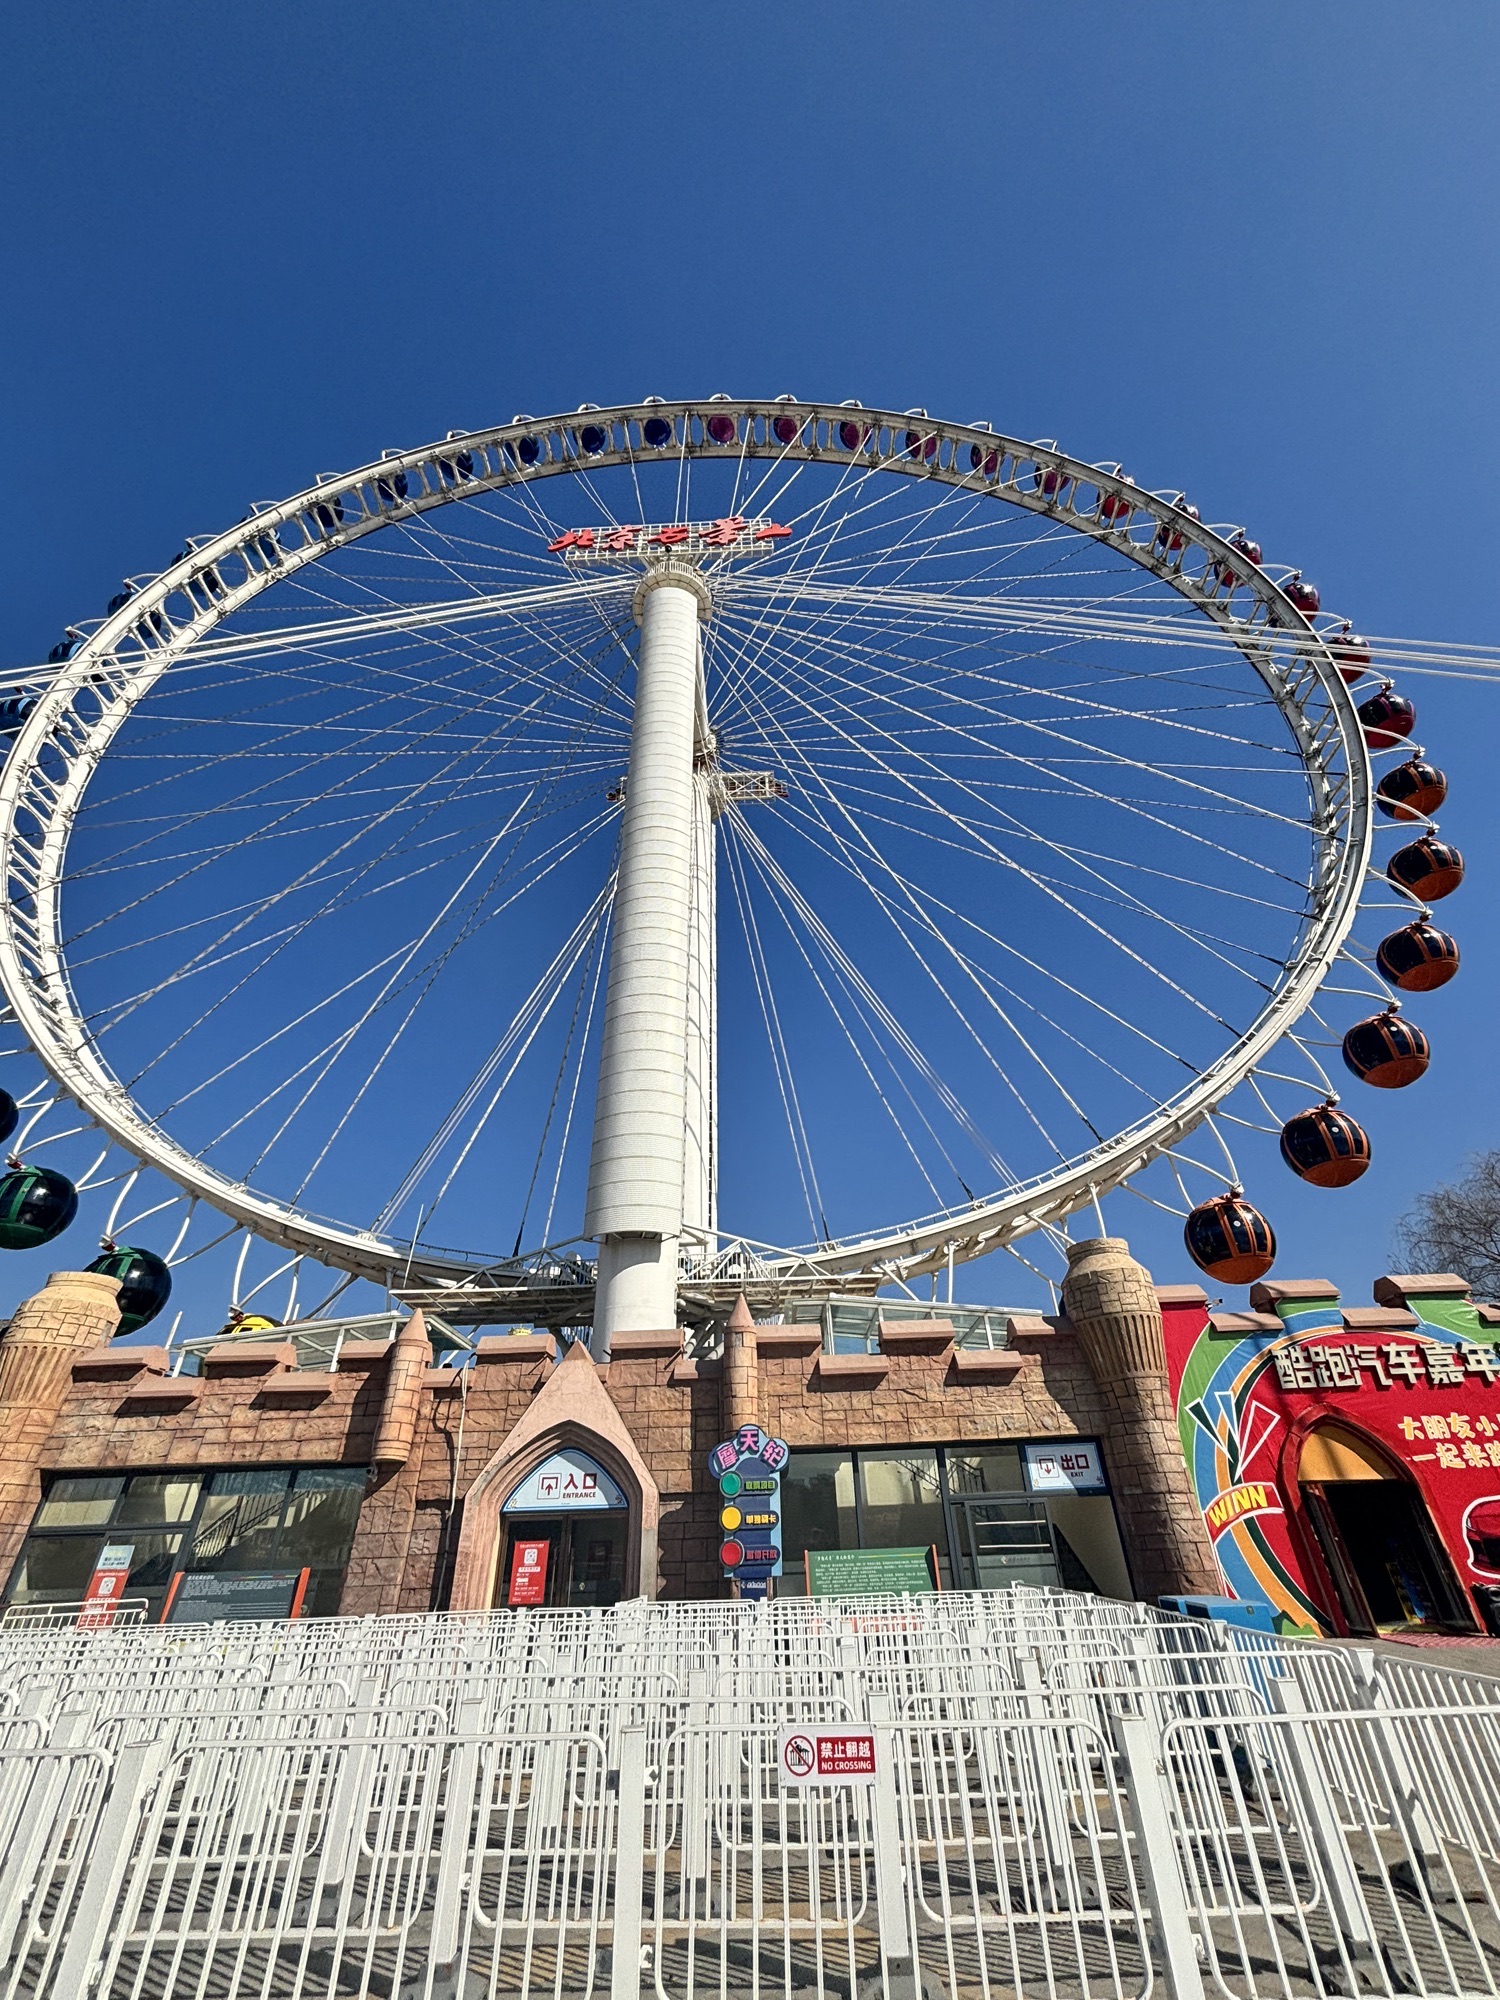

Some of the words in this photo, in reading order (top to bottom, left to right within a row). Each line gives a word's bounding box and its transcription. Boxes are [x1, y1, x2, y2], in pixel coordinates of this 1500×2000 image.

[1397, 1412, 1500, 1441] 大朋友小
[716, 1429, 786, 1469] 摩天轮
[1060, 1454, 1090, 1470] 出口
[563, 1472, 598, 1490] 入口
[562, 1491, 597, 1499] ENTRANCE
[1208, 1485, 1268, 1528] WINN
[820, 1741, 871, 1758] 禁止翻越
[821, 1761, 833, 1770] NO
[834, 1760, 872, 1770] CROSSING
